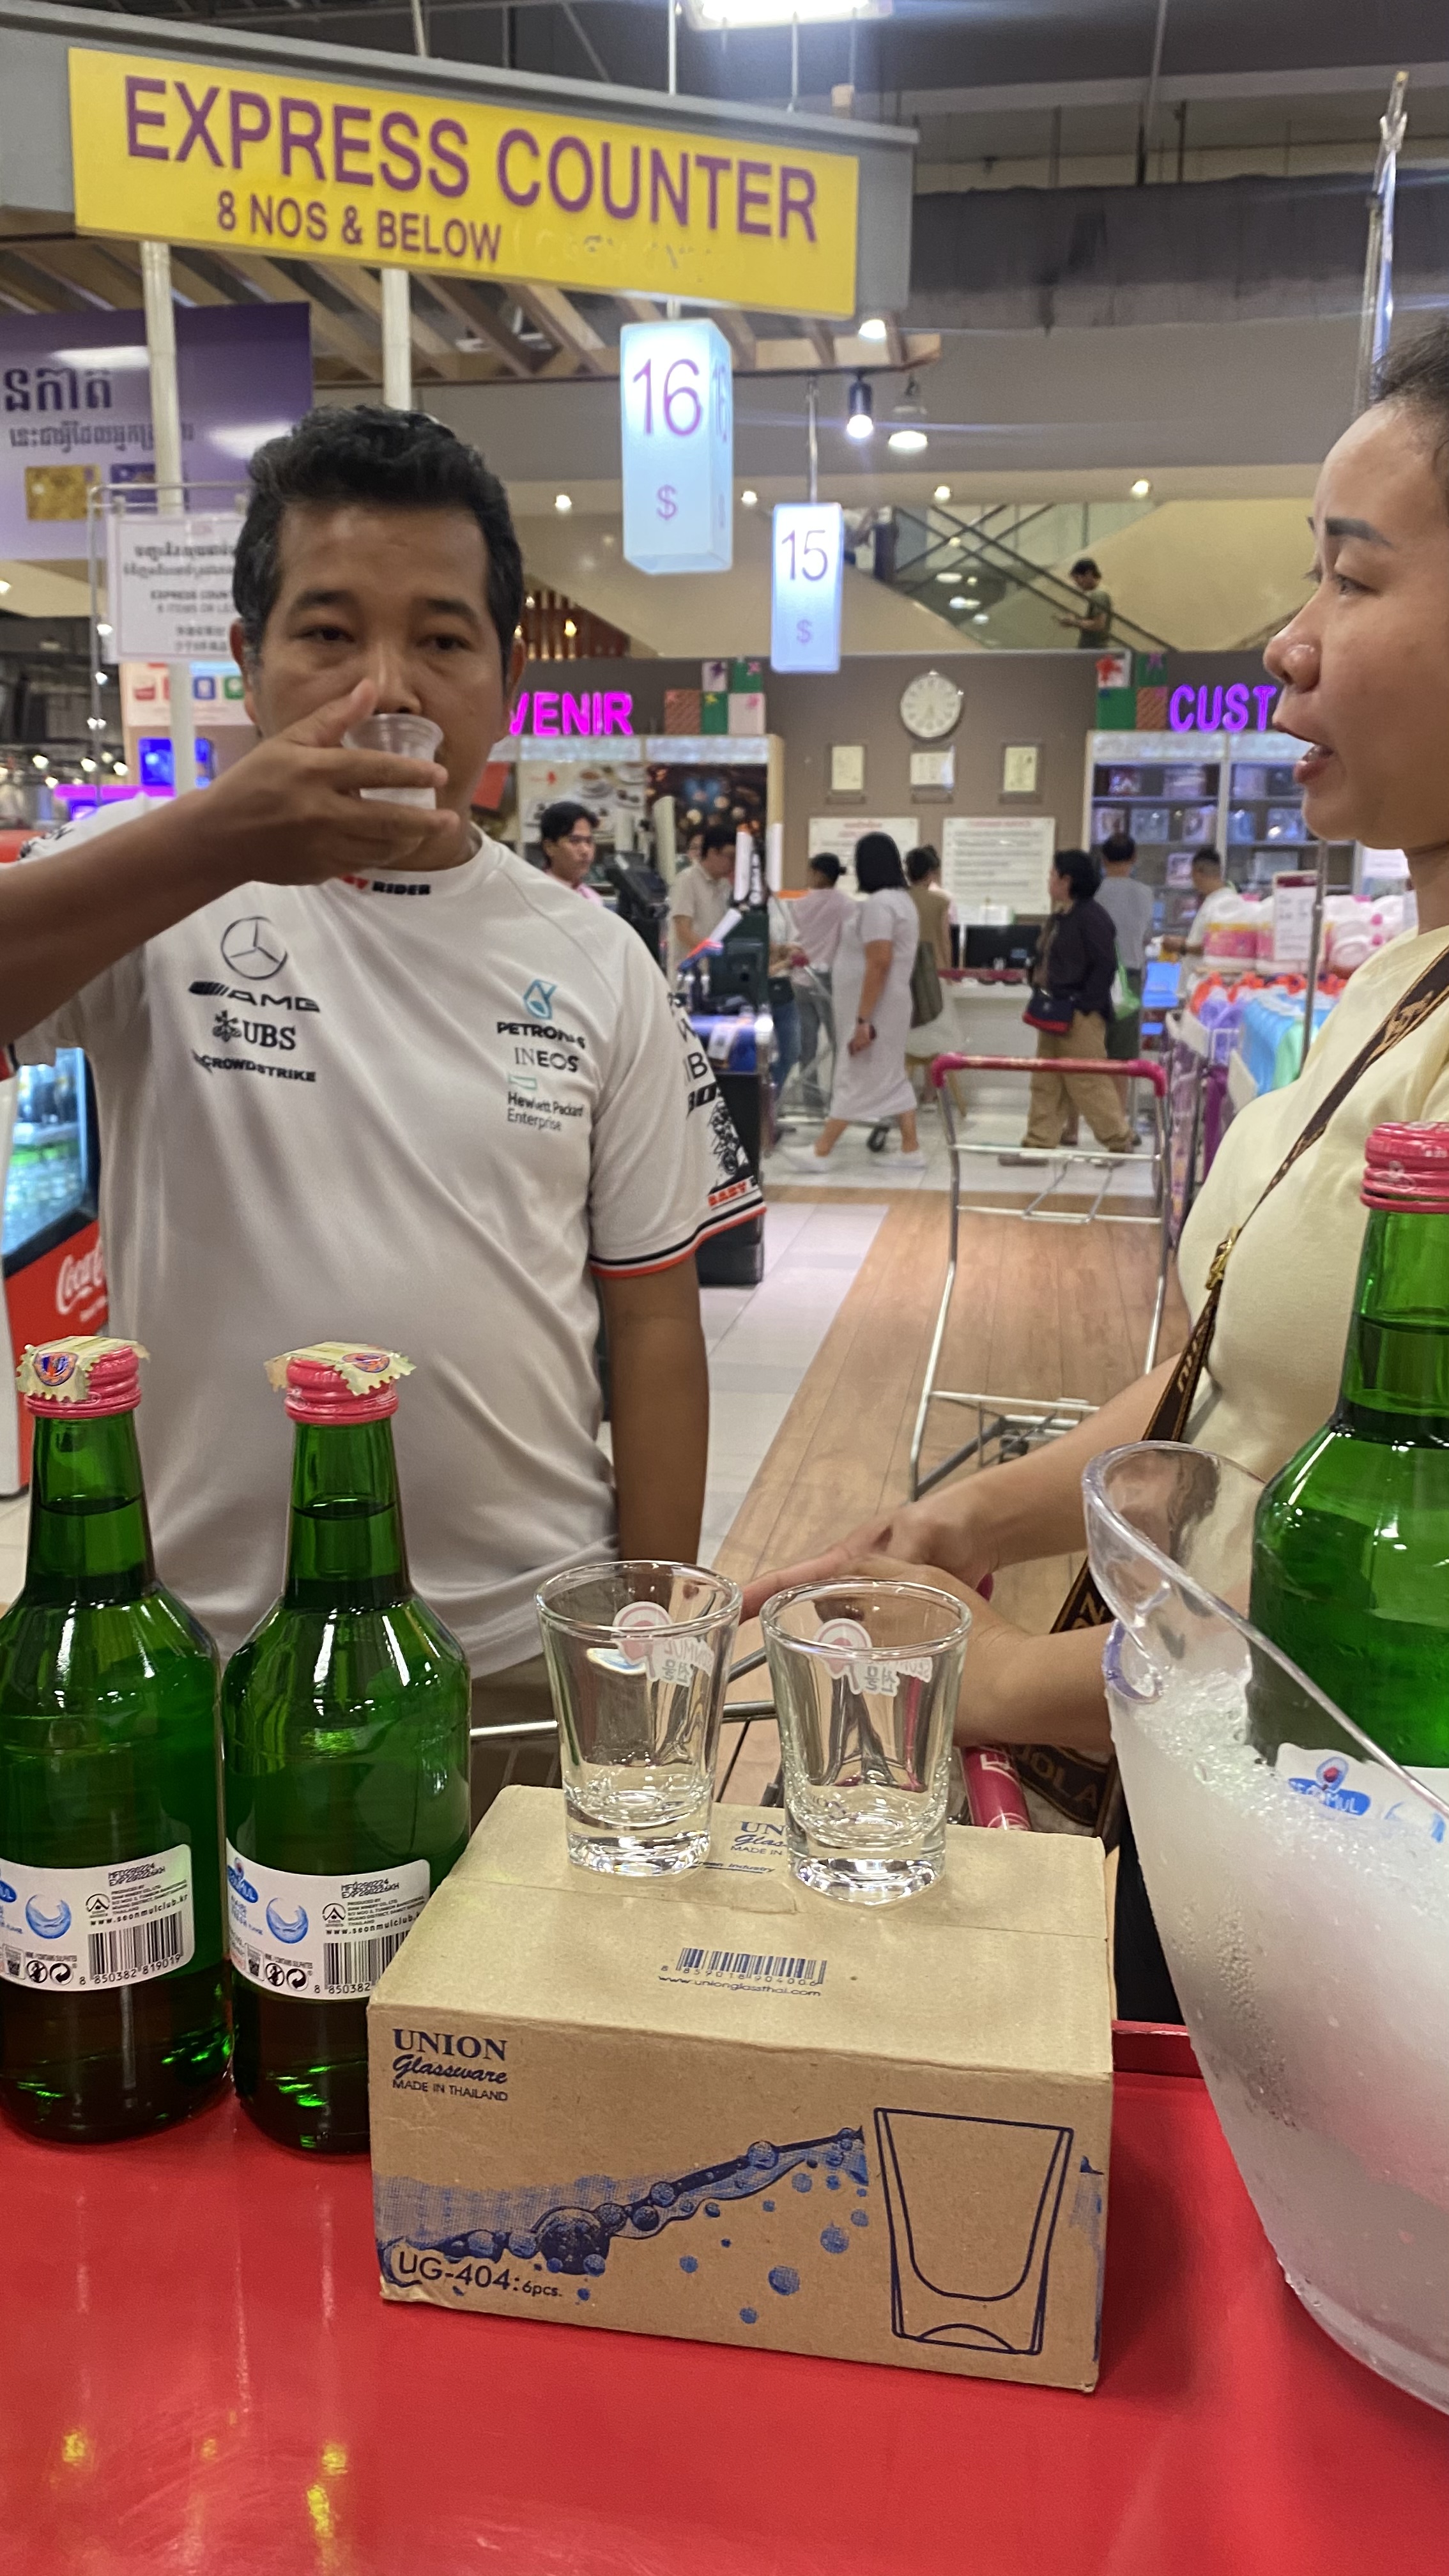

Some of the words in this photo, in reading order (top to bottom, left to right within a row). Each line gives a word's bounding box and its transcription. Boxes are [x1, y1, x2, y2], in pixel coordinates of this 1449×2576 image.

[125, 75, 470, 198] EXPRESS
[496, 128, 817, 243] COUNTER
[217, 190, 236, 231] 8
[250, 194, 328, 241] NOS
[342, 206, 363, 245] &
[377, 210, 502, 263] BELOW
[633, 358, 702, 436] 16
[656, 484, 678, 521] $
[781, 529, 829, 582] 15
[796, 618, 813, 644] $
[509, 691, 634, 737] VENIR
[1169, 683, 1277, 733] CUST
[372, 880, 431, 895] RIDER
[227, 989, 321, 1013] AMG
[242, 1020, 296, 1051] UBS
[201, 1055, 316, 1082] CROWDSTRIKE
[514, 1046, 579, 1073] INEOS
[507, 1091, 551, 1113] Hewlett
[507, 1108, 563, 1131] Enterprise
[730, 1845, 766, 1855] MADE
[325, 1912, 421, 1935] www.seonmulclub.k
[79, 1976, 86, 1985] 8
[94, 1969, 137, 1984] 850382
[142, 1954, 181, 1975] 819019
[682, 1968, 745, 1979] 859018
[756, 1975, 818, 1986] 904006
[314, 1984, 321, 1994] 8
[328, 1982, 371, 1995] 850382
[658, 1975, 821, 1997] www.unionglassthai.com
[392, 2028, 508, 2062] UNION
[392, 2053, 508, 2085] Glassware
[392, 2079, 428, 2092] MADE
[433, 2083, 445, 2094] IN
[449, 2085, 509, 2101] THAILAND
[399, 2250, 519, 2292] UG-404:
